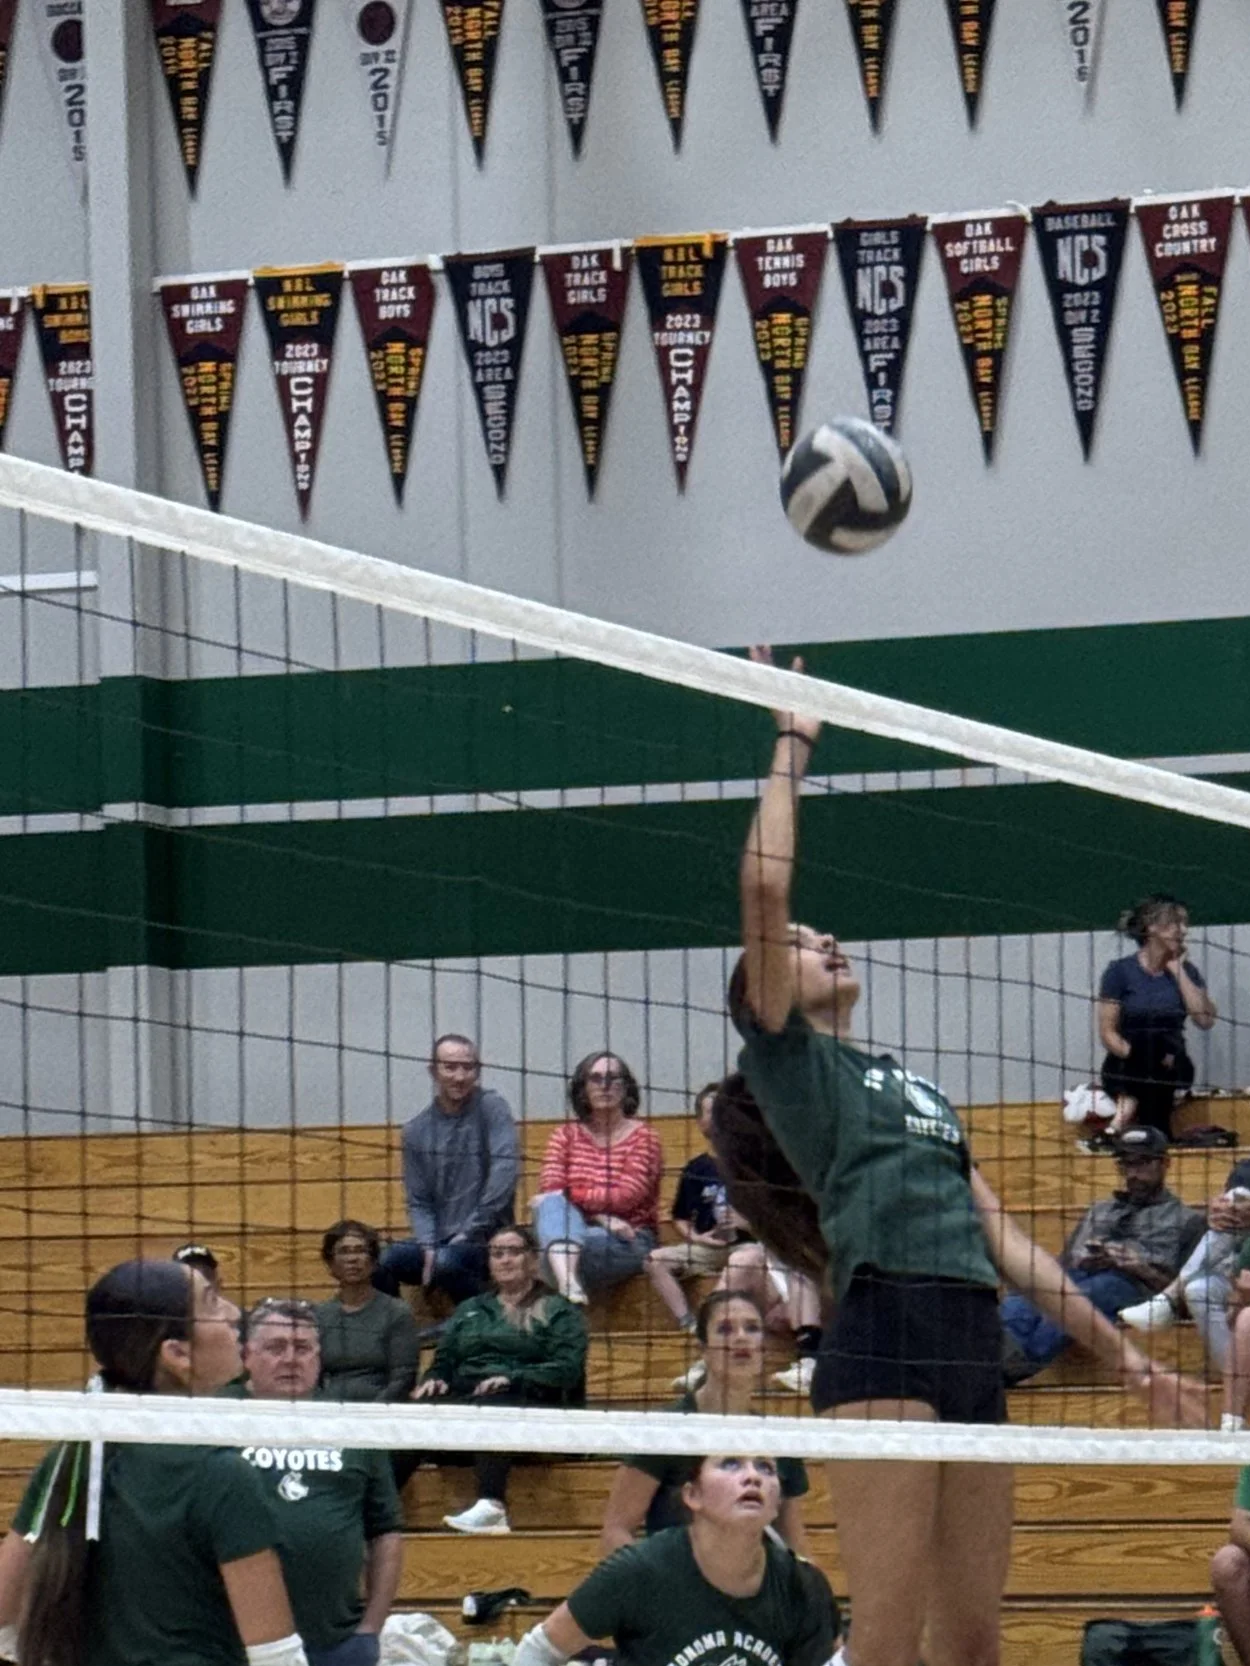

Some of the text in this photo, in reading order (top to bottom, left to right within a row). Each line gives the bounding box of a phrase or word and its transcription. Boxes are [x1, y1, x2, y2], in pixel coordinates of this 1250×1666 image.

[1168, 202, 1200, 221] OAK
[964, 221, 993, 238] OAK
[1161, 220, 1208, 241] CROSS
[765, 237, 794, 254] OAK
[944, 238, 1015, 259] SOFTBALL
[1154, 238, 1218, 259] COUNTRY
[571, 253, 601, 270] OAK
[756, 253, 805, 273] TENNIS
[856, 246, 903, 265] TRACK
[1055, 235, 1108, 288] NCS
[959, 256, 1001, 275] GIRLS
[380, 269, 408, 285] OAK
[563, 269, 609, 288] TRACK
[762, 271, 798, 289] BOYS
[190, 284, 217, 300] OAK
[373, 285, 417, 303] TRACK
[566, 287, 609, 305] GIRLS
[855, 265, 906, 317] NCS
[378, 302, 411, 320] BOYS
[186, 319, 224, 334] GIRLS
[467, 297, 516, 348] NCS
[665, 313, 702, 330] 2023
[652, 330, 712, 349] TOURNEY
[862, 335, 901, 354] AREA
[273, 358, 329, 375] TOURNEY
[474, 366, 515, 384] AREA
[668, 346, 695, 463] CHAMPIONS
[288, 376, 315, 490] CHAMPIONS
[240, 1445, 344, 1473] COYOTES
